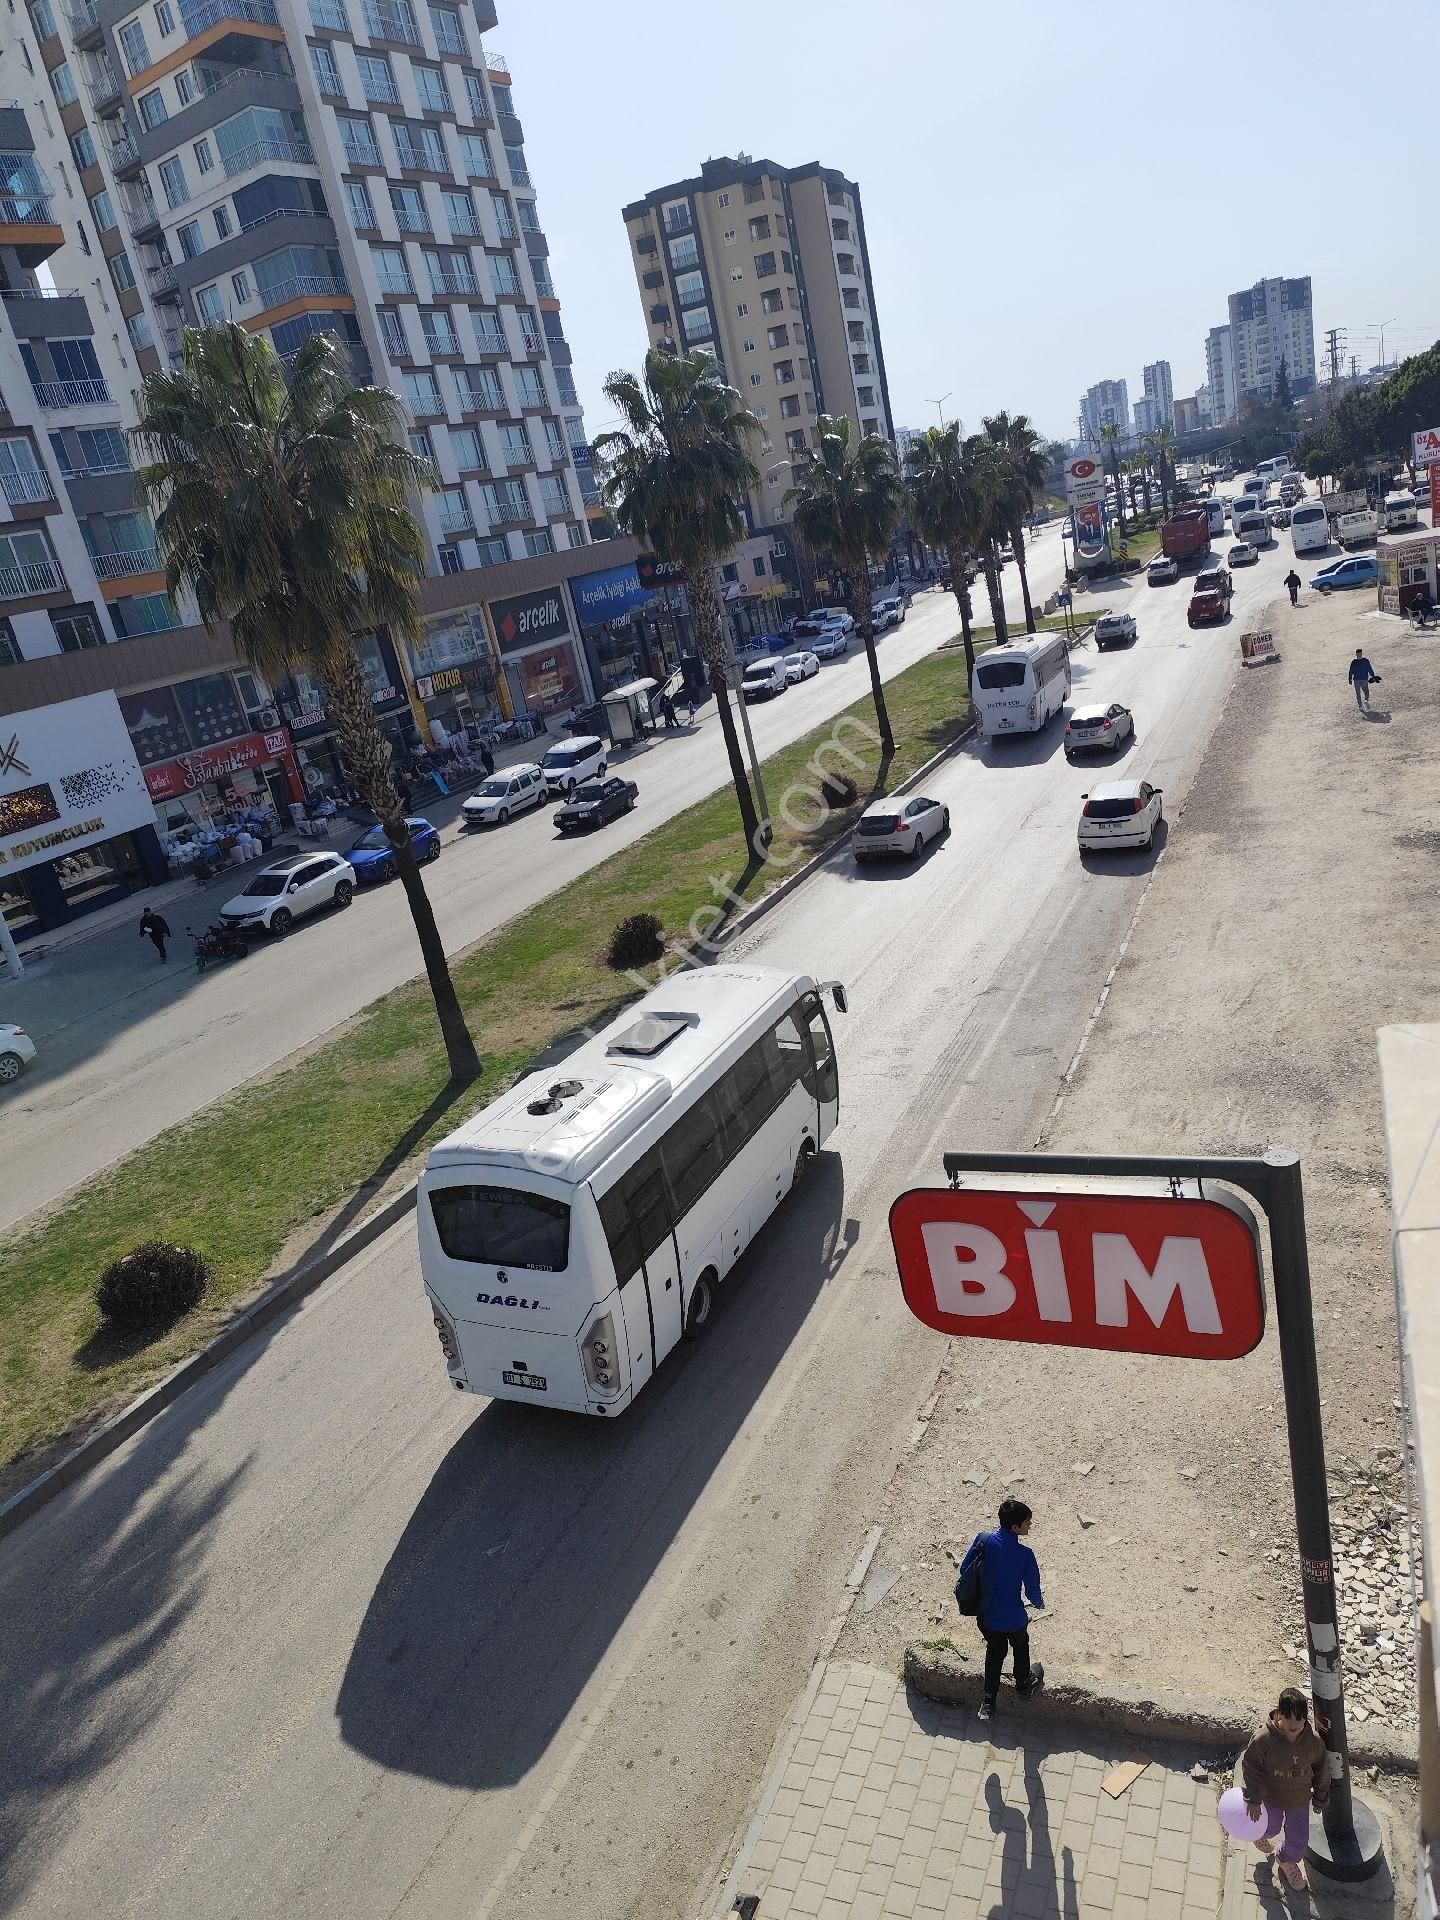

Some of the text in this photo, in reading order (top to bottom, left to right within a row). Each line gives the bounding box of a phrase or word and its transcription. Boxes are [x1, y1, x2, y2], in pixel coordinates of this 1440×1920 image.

[1418, 449, 1440, 461] KURU
[518, 599, 561, 635] arçelik
[431, 668, 462, 693] HUZUR
[469, 1190, 526, 1204] TEMSA
[919, 1199, 1224, 1336] BİM
